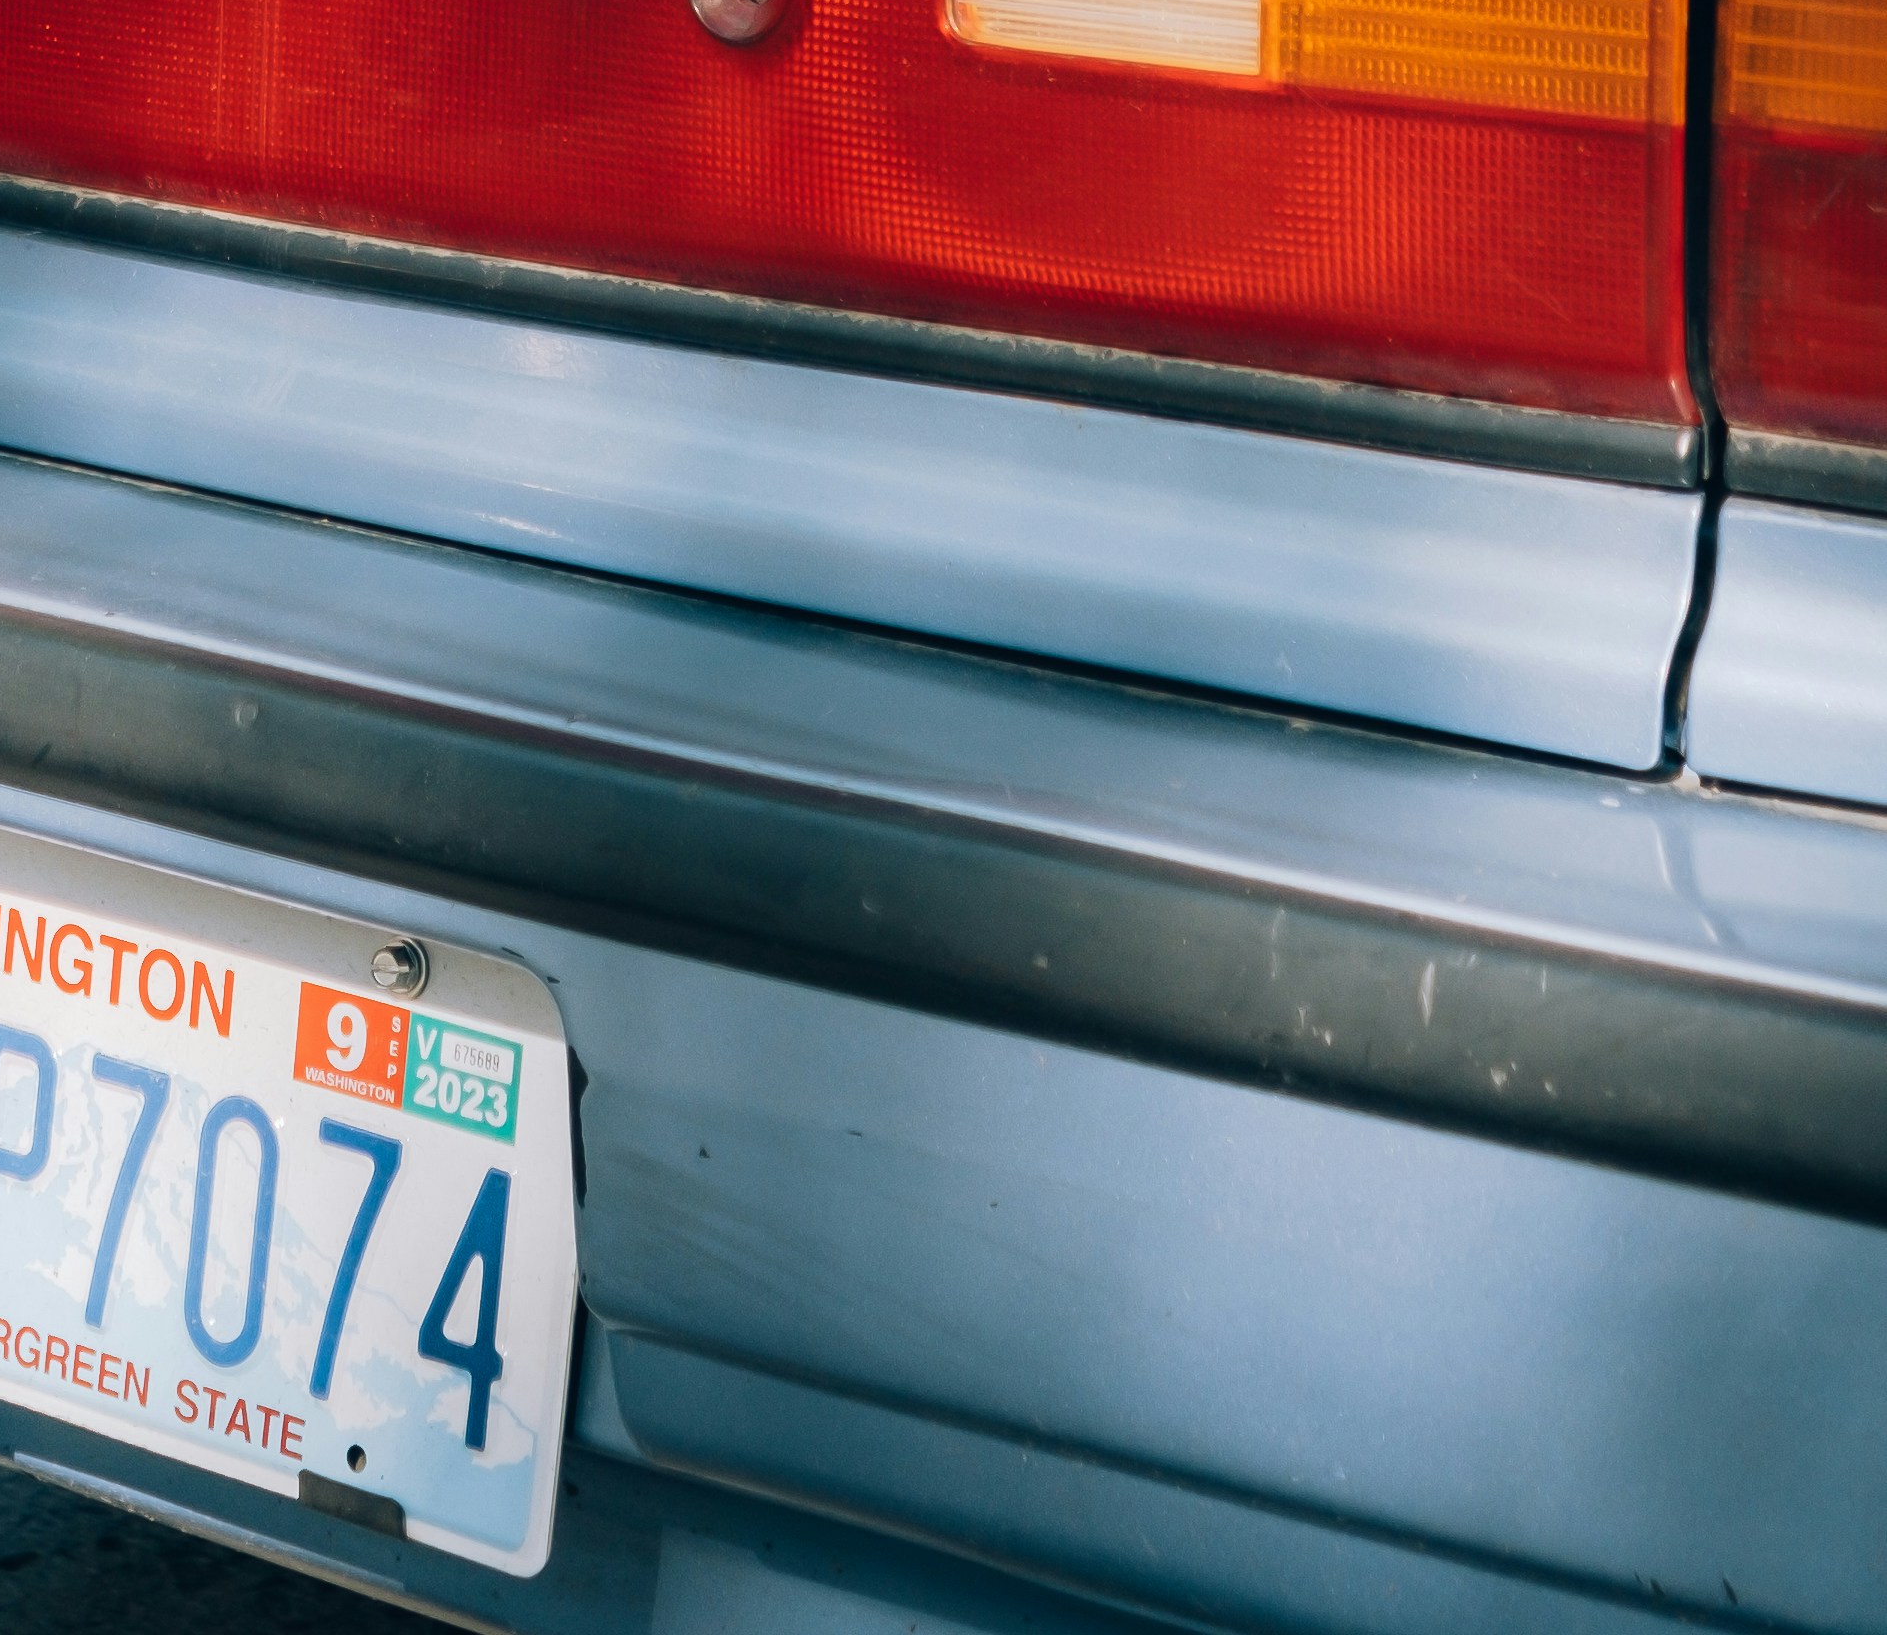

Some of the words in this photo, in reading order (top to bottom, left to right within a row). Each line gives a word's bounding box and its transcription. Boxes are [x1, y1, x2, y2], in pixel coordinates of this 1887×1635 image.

[326, 1002, 367, 1072] 9
[416, 1023, 438, 1060] V
[305, 1066, 395, 1104] WASHINGTON
[413, 1064, 508, 1128] 2023
[174, 1379, 307, 1462] STATE
